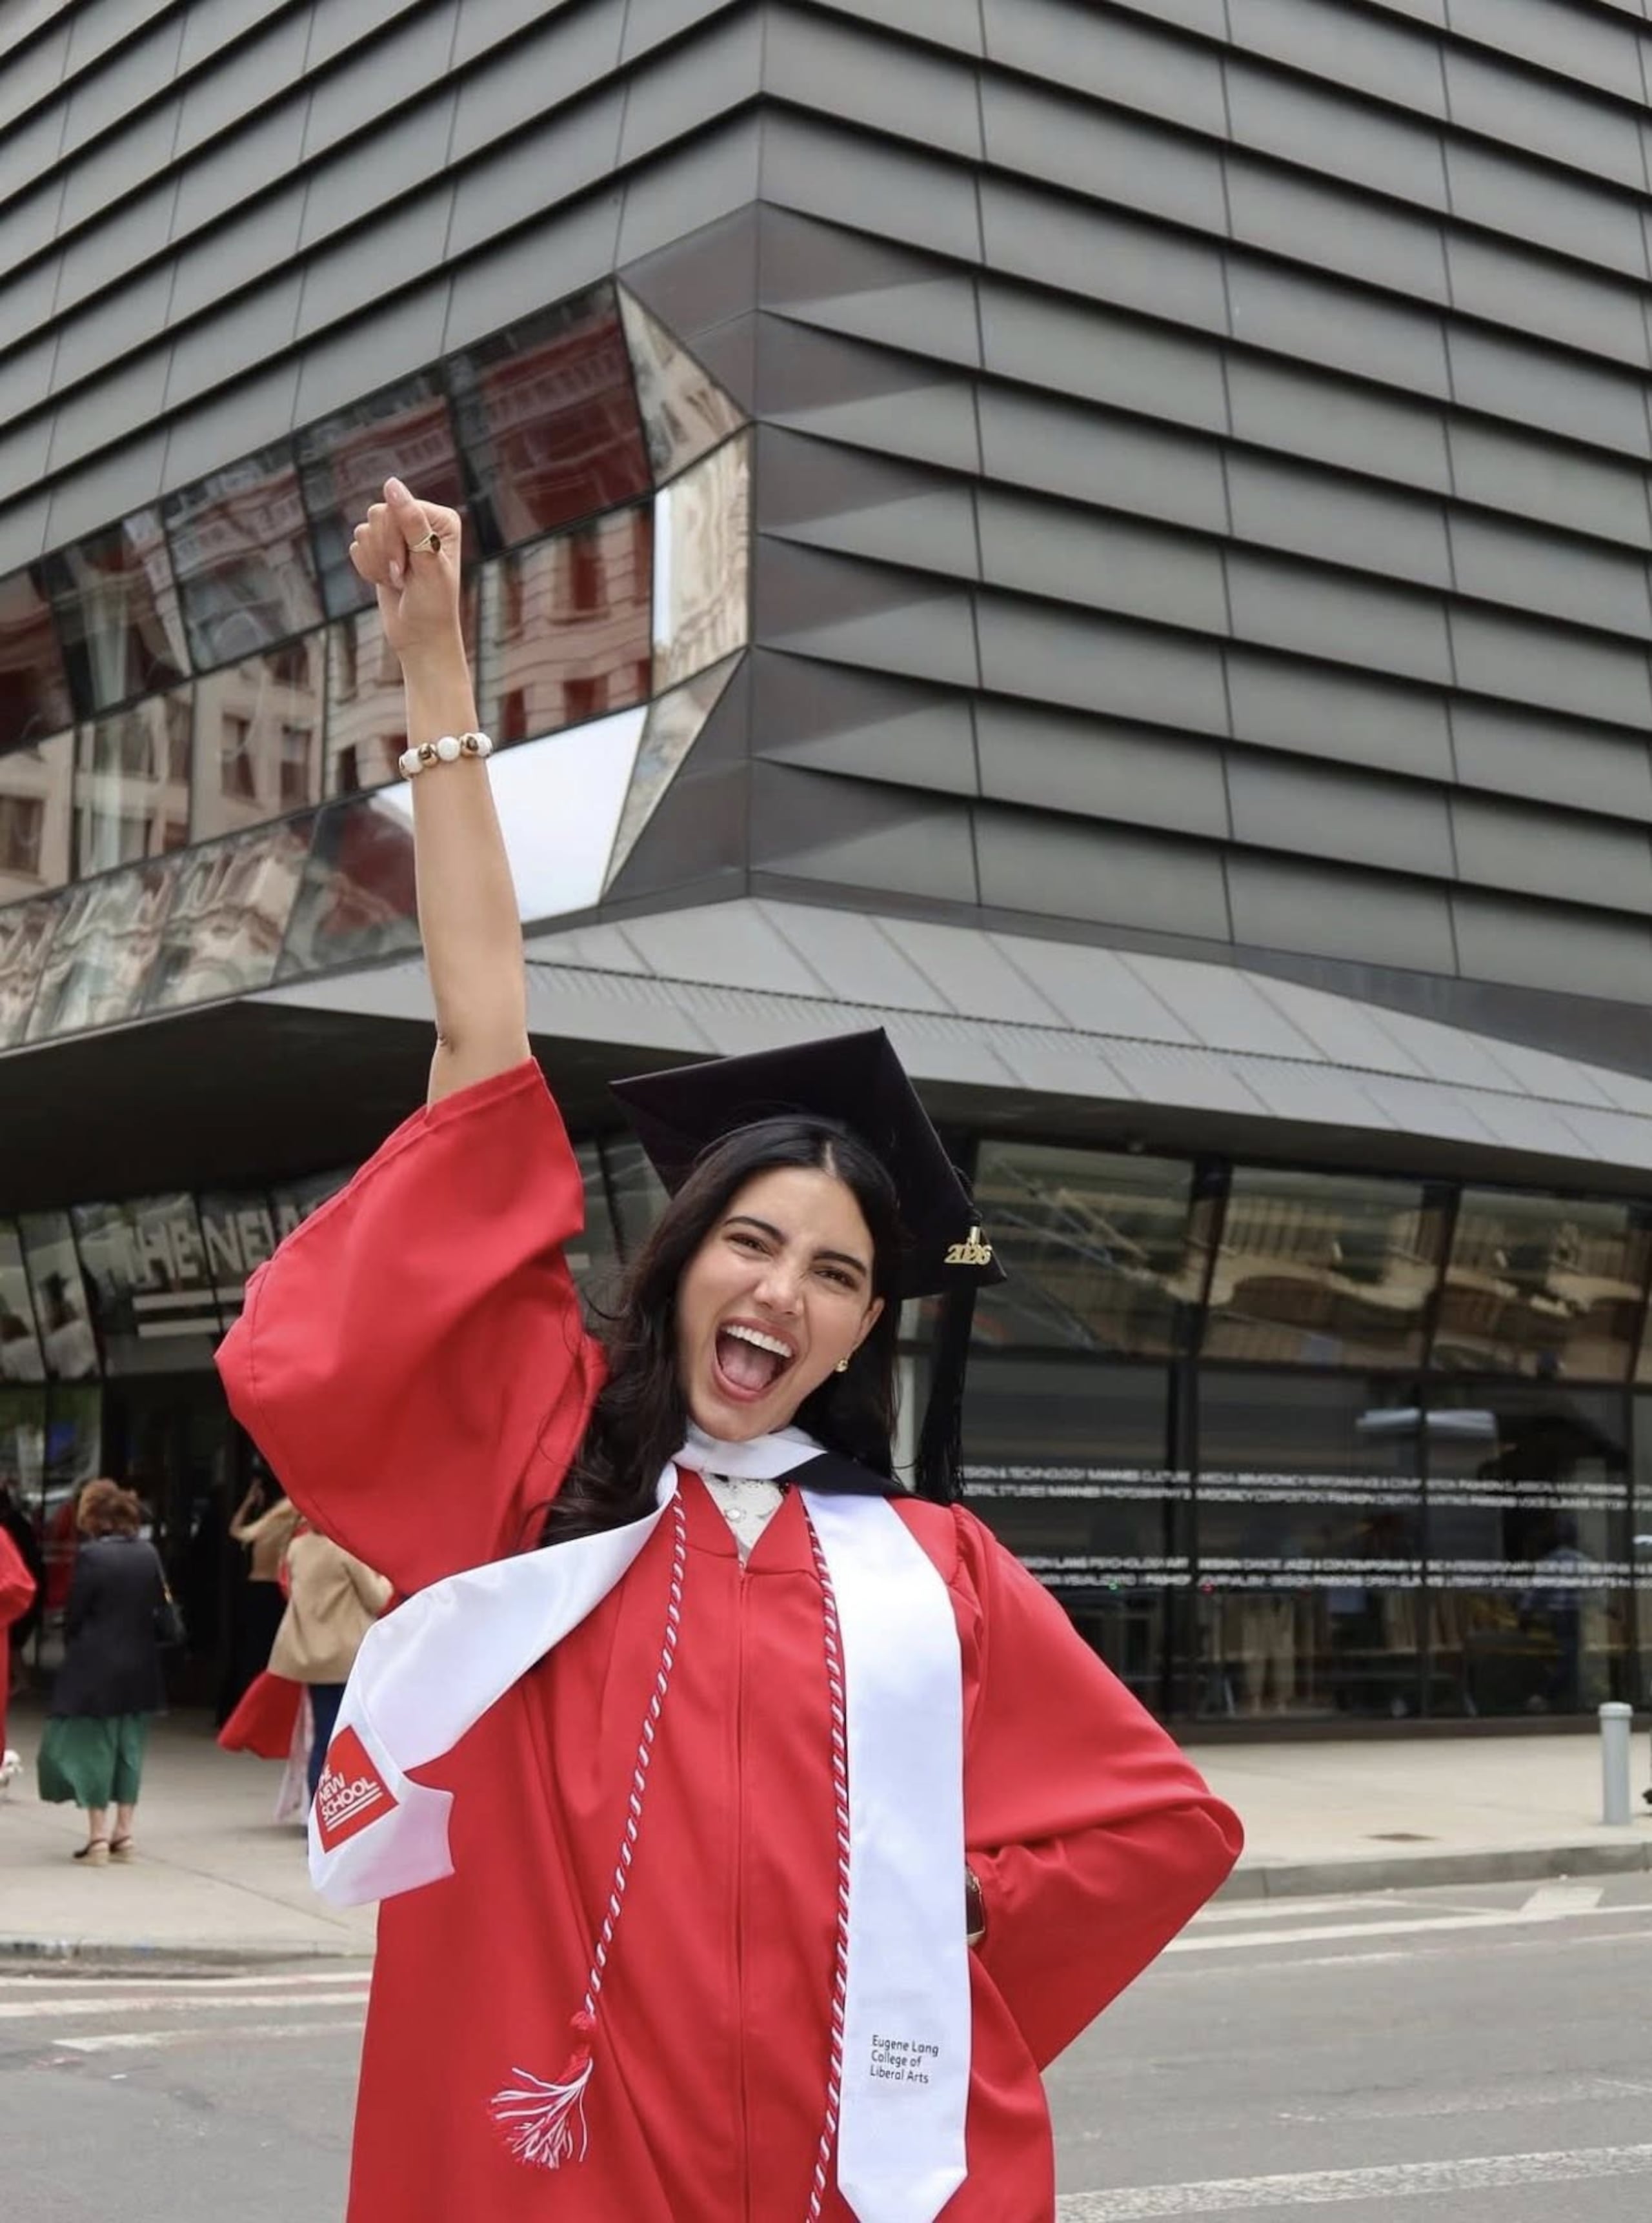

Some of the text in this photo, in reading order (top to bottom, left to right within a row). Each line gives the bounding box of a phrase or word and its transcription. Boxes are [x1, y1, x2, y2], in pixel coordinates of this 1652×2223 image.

[943, 1243, 992, 1265] 2026
[319, 1771, 345, 1806] NEW
[321, 1776, 378, 1822] SCHOOL
[872, 2035, 939, 2057] Eugene Lang
[871, 2049, 922, 2067] College of
[870, 2064, 929, 2084] Liberal Arts
